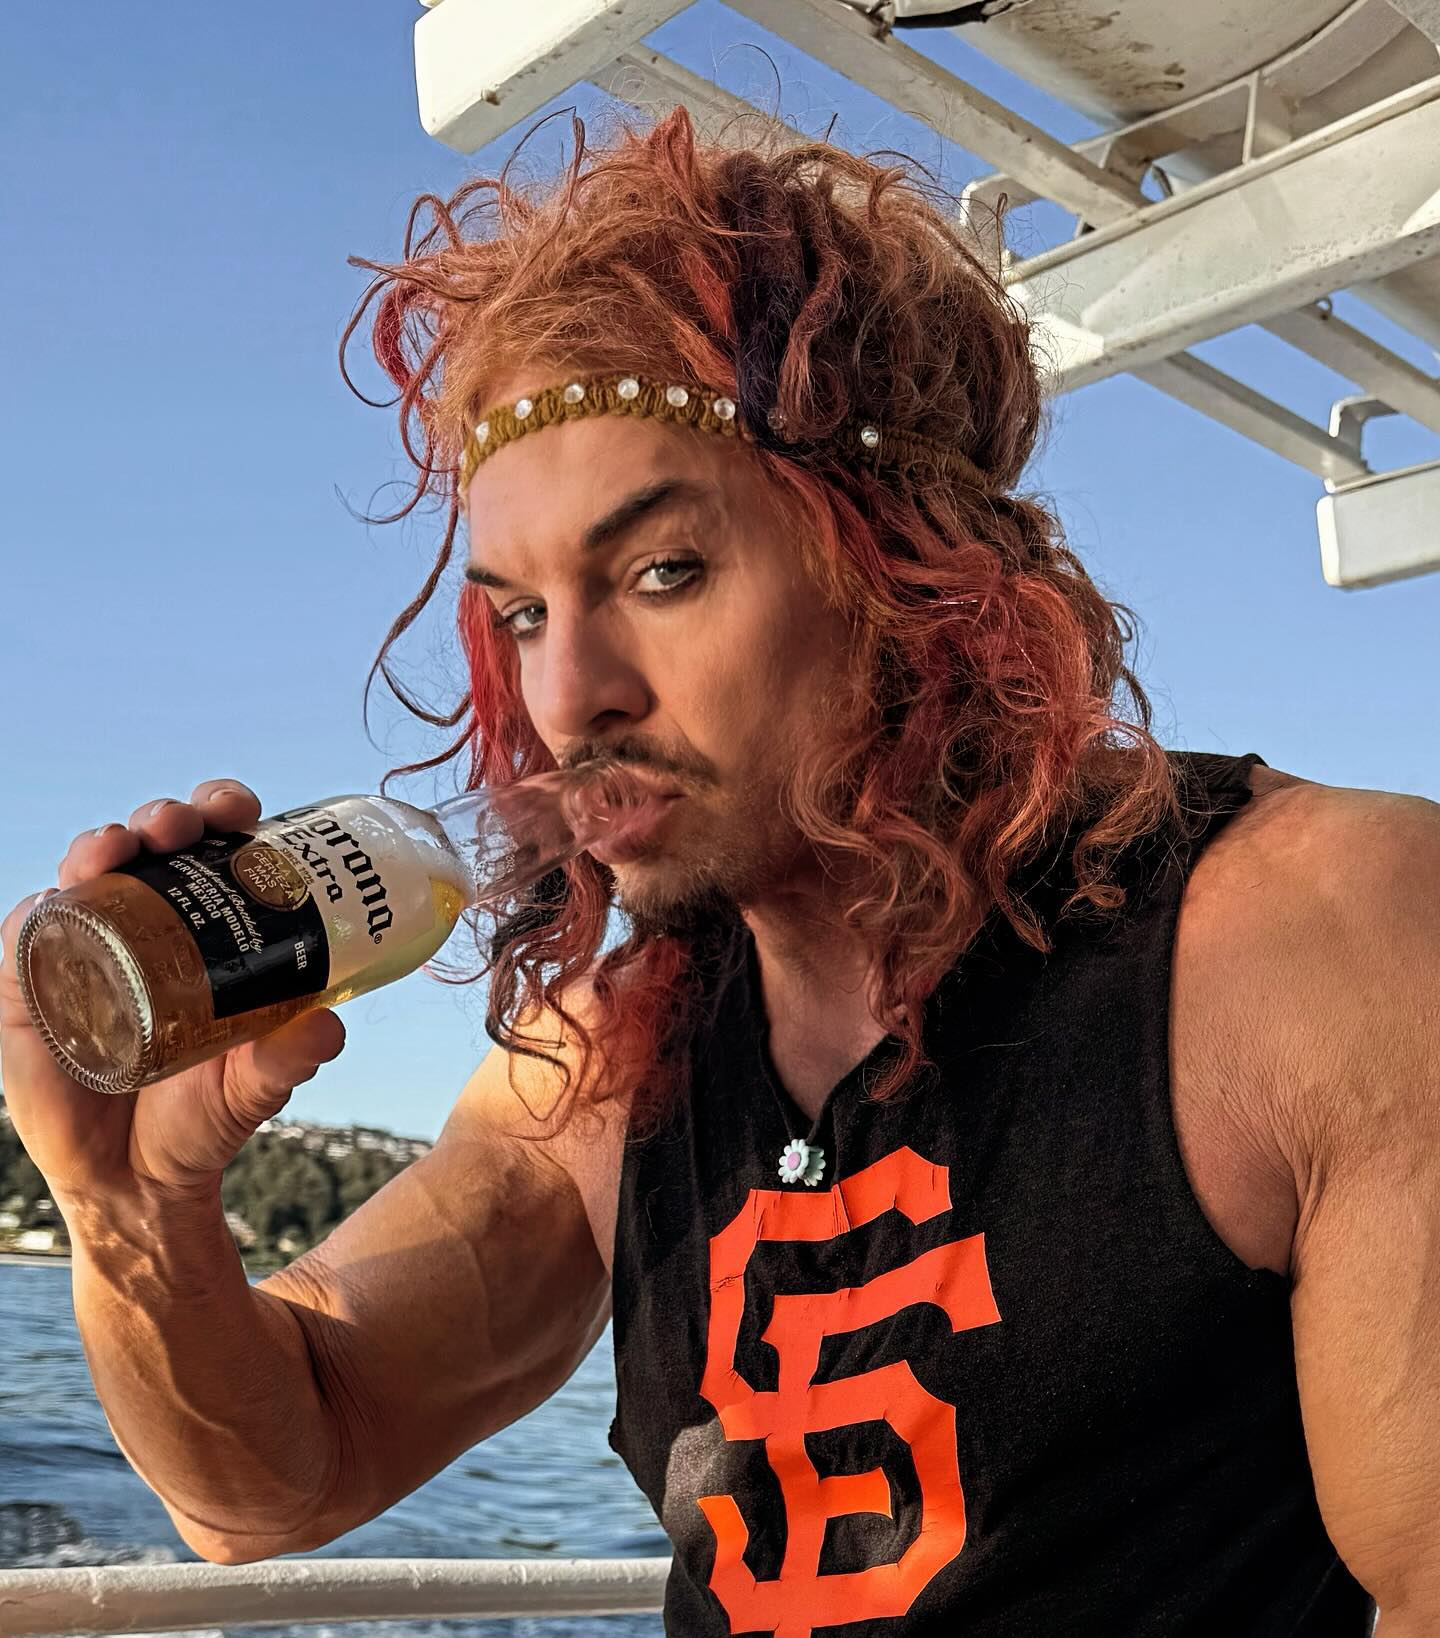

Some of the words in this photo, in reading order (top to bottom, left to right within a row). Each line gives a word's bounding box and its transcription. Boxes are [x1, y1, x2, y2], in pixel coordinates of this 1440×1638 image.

[252, 851, 294, 899] CERVEZA
[254, 864, 277, 888] MAS
[272, 807, 393, 937] Corona
[275, 861, 291, 878] LA
[280, 827, 343, 904] Extra
[281, 847, 302, 868] SINCE
[185, 879, 222, 919] MEXICO
[243, 868, 267, 892] FINA
[167, 886, 181, 898] 12
[177, 895, 193, 912] FL.
[189, 911, 206, 930] OZ.
[168, 860, 225, 906] CERVECERIA
[221, 906, 250, 953] MODELO
[294, 940, 307, 970] BEER
